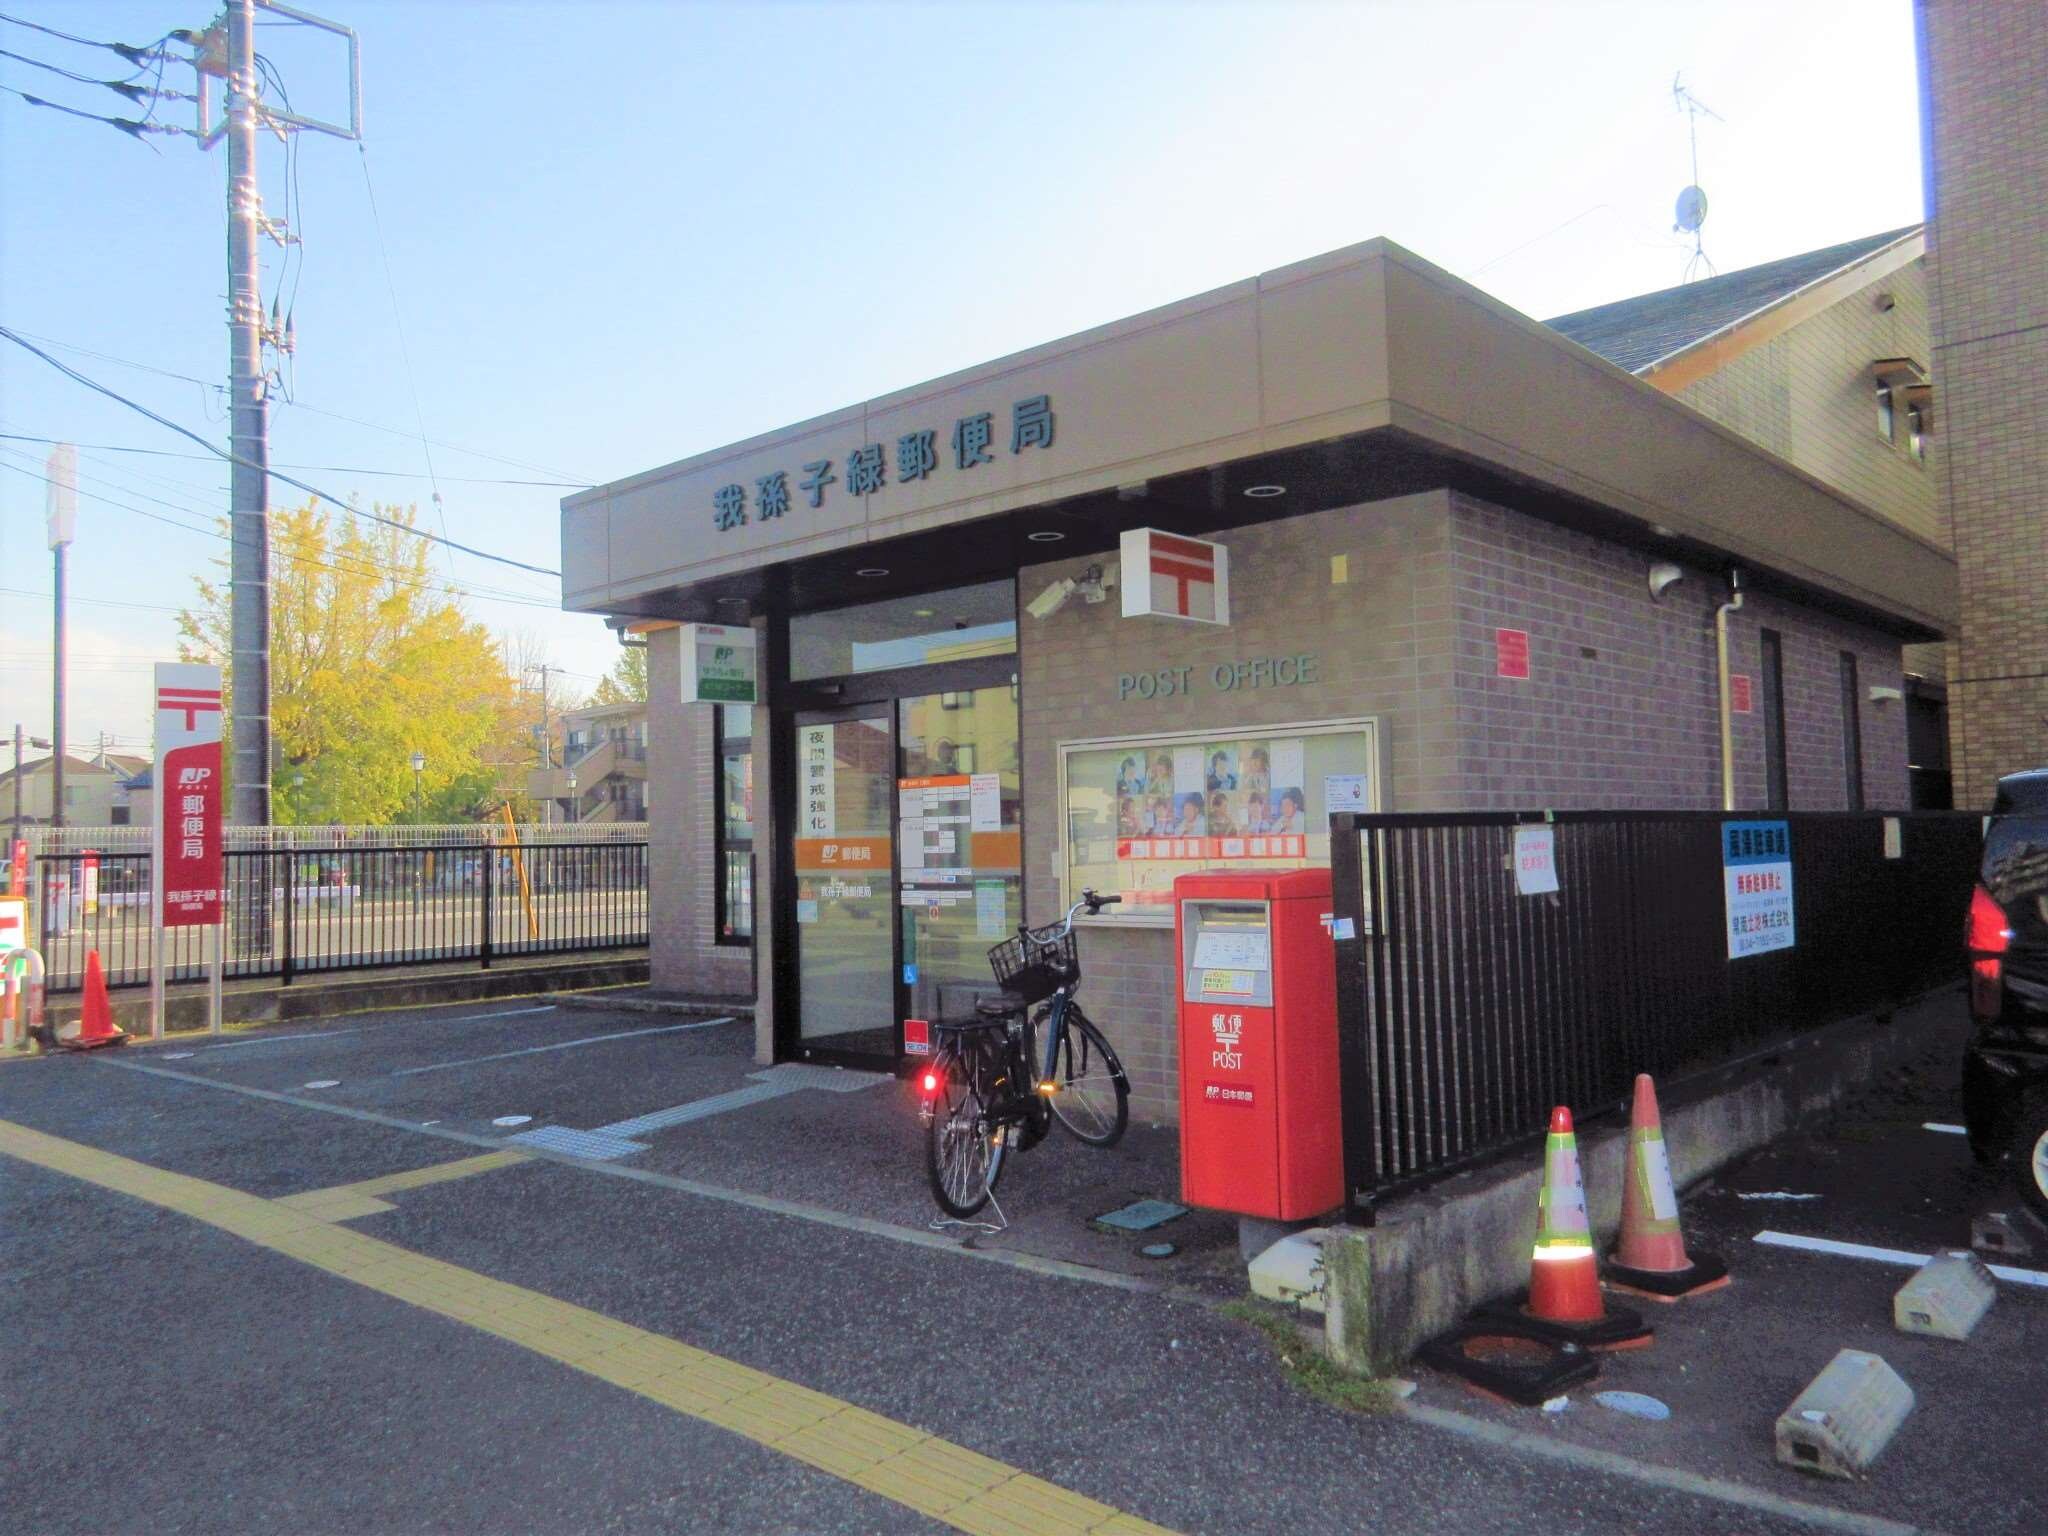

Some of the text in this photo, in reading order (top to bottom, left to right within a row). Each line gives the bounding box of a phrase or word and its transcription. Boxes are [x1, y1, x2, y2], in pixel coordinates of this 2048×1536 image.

[713, 394, 1054, 531] 我孫子緑郵便局
[1119, 654, 1318, 700] POST OFFICE
[810, 731, 826, 829] 夜間警戒強化
[181, 795, 204, 859] 郵便局
[842, 847, 871, 861] 郵便局
[167, 890, 216, 903] 我孫子緑
[1212, 1014, 1242, 1034] 郵便
[1213, 1051, 1242, 1070] POST
